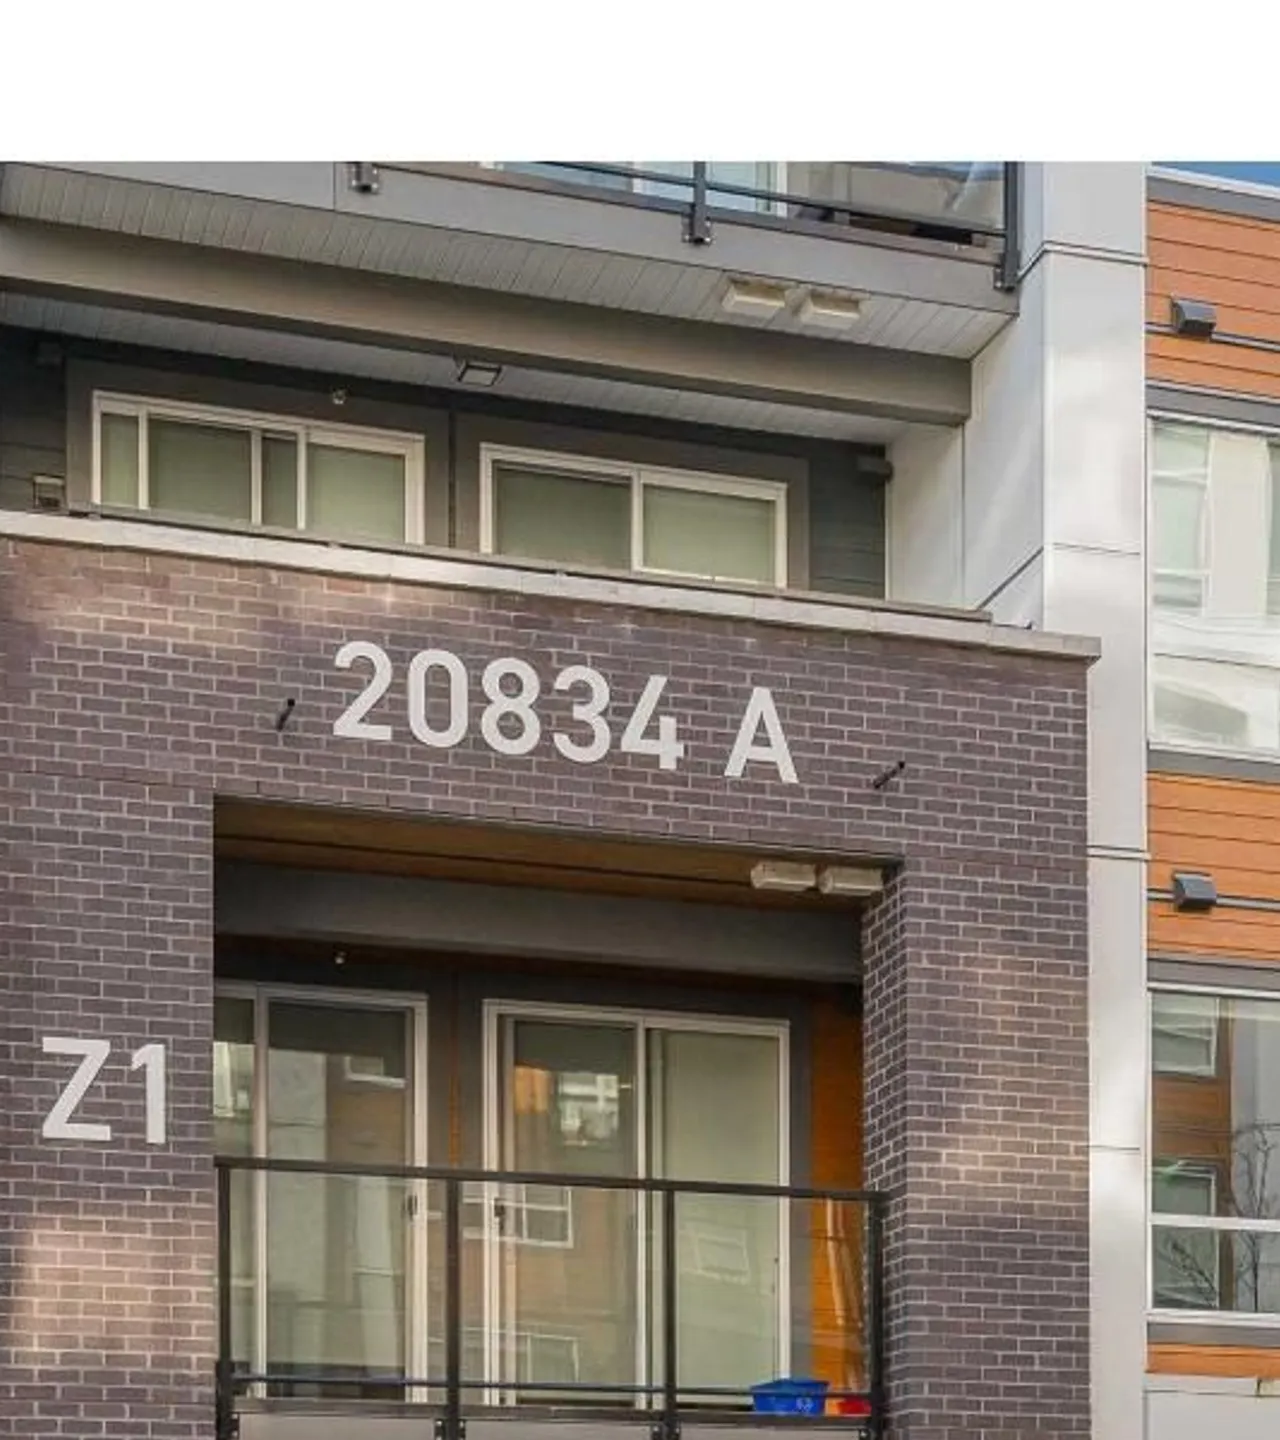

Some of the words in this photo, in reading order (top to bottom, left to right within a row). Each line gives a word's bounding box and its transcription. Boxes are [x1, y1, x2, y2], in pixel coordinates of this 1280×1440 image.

[333, 640, 686, 771] 20834
[724, 686, 799, 784] A
[39, 1036, 168, 1146] Z1
